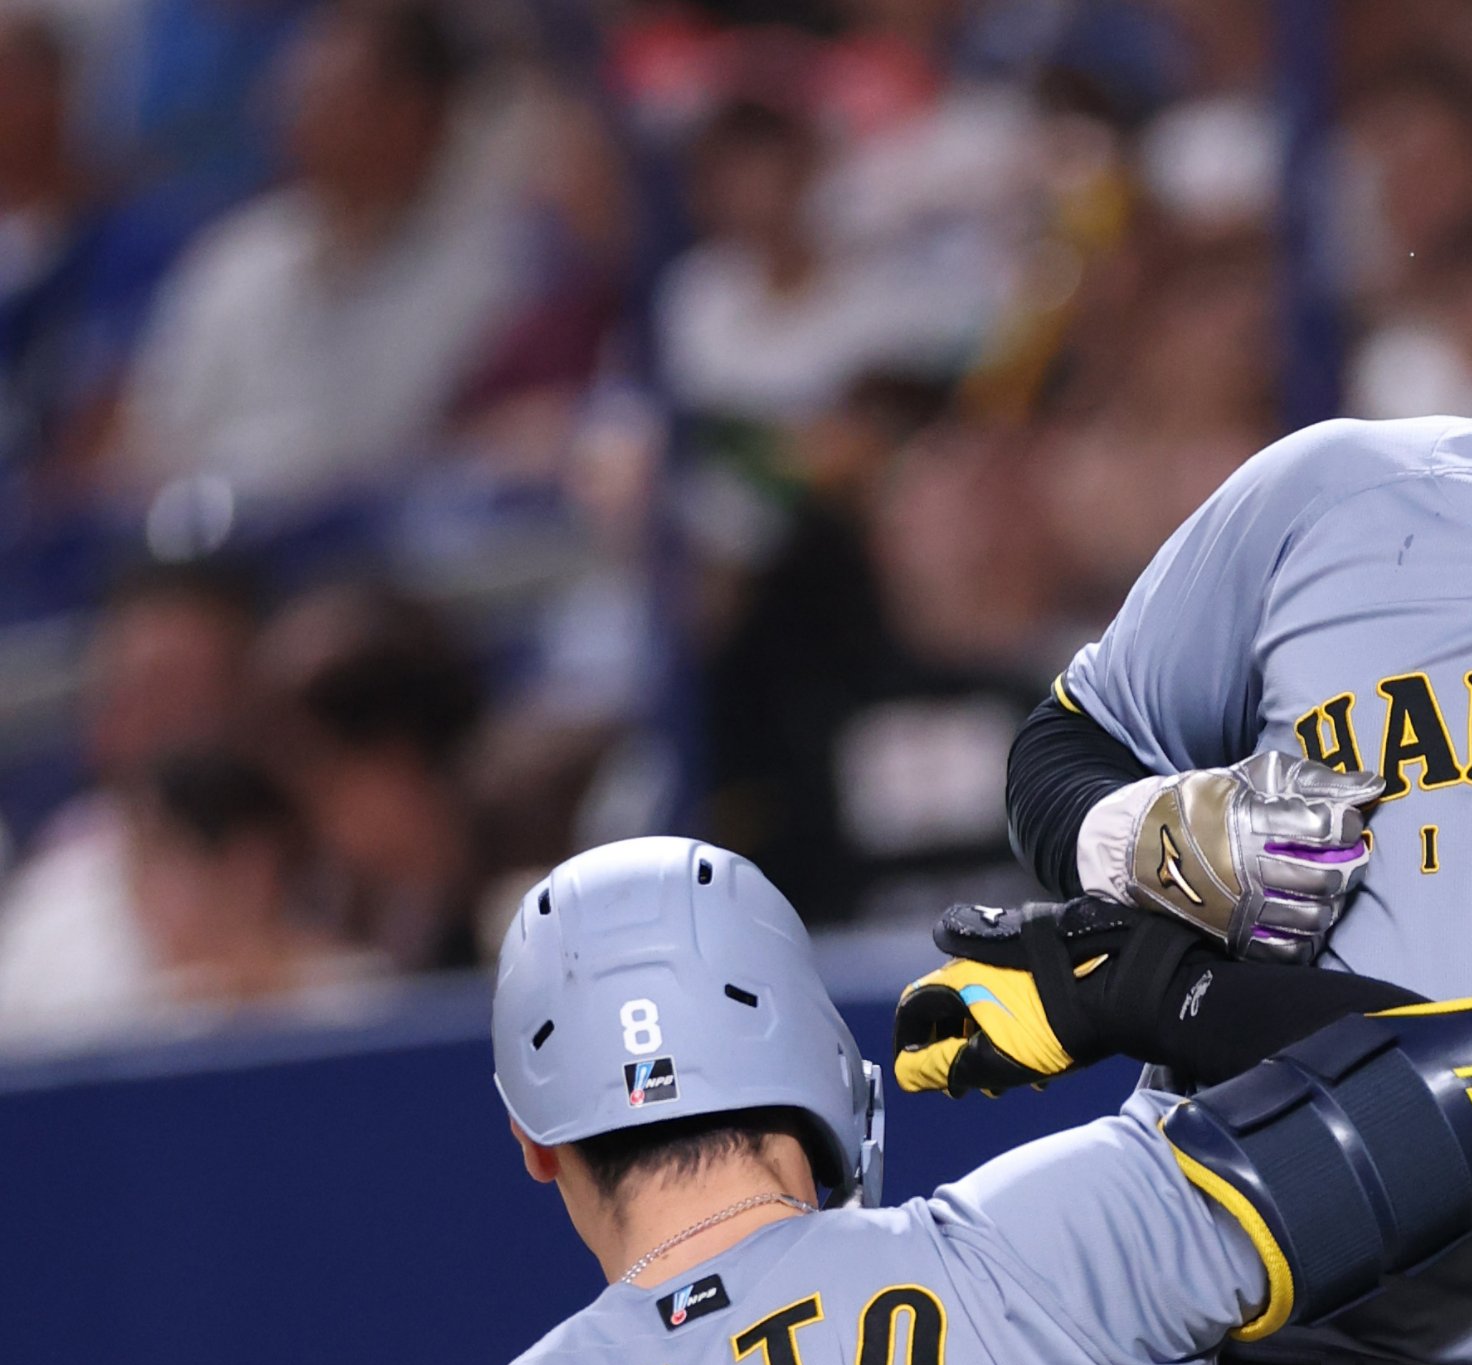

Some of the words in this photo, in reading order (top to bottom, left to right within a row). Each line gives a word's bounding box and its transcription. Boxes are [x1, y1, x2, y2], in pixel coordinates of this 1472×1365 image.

[619, 998, 663, 1055] 8
[645, 1074, 675, 1089] NPB
[687, 1286, 718, 1307] NPB
